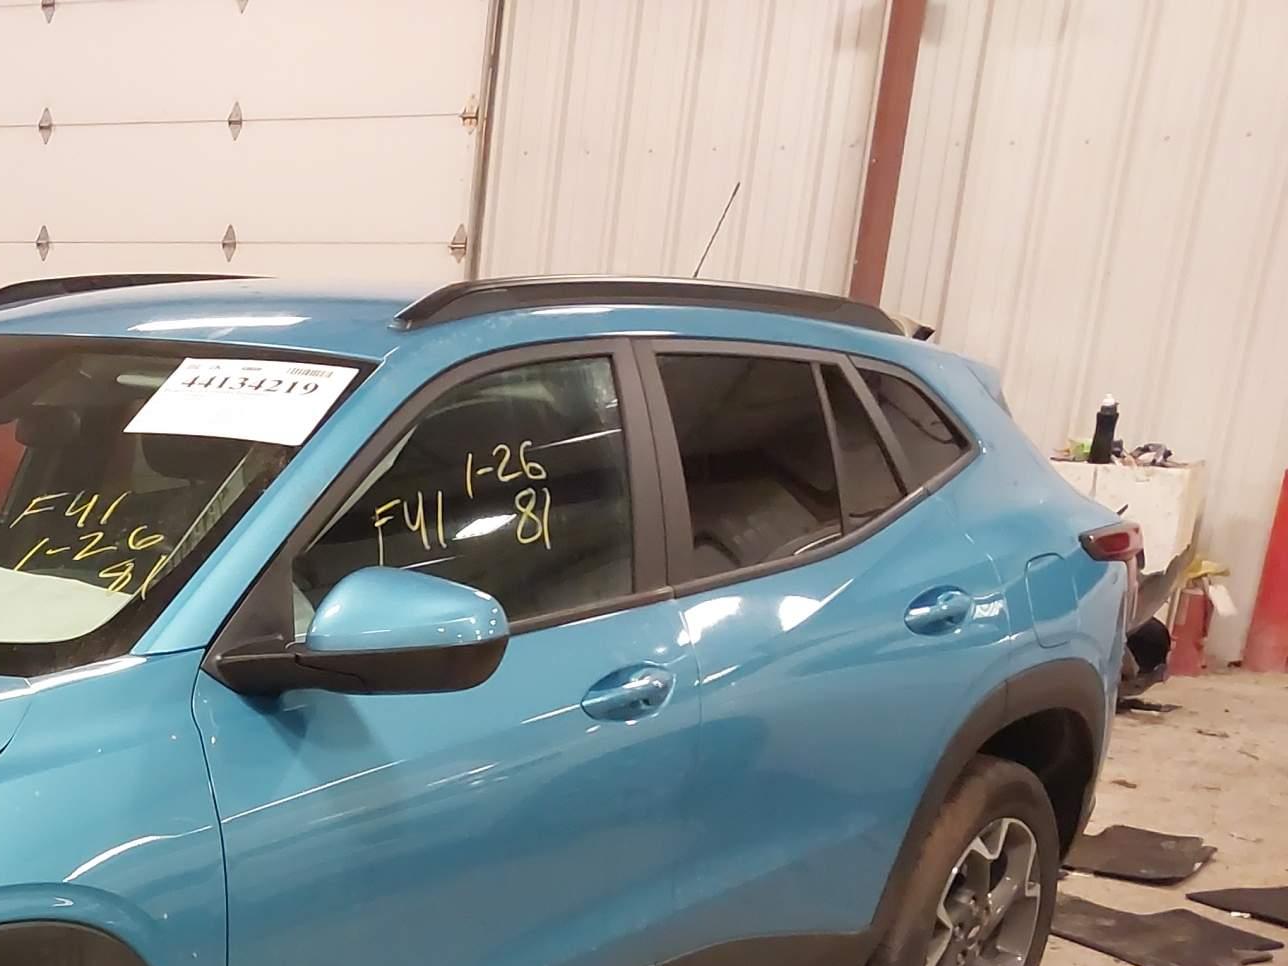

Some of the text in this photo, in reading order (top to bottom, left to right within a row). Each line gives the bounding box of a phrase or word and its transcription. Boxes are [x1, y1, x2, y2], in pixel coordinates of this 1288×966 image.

[180, 374, 320, 396] 44134219
[465, 440, 548, 499] 1-26
[9, 490, 132, 529] F41
[373, 490, 448, 567] F41
[514, 487, 553, 551] 81
